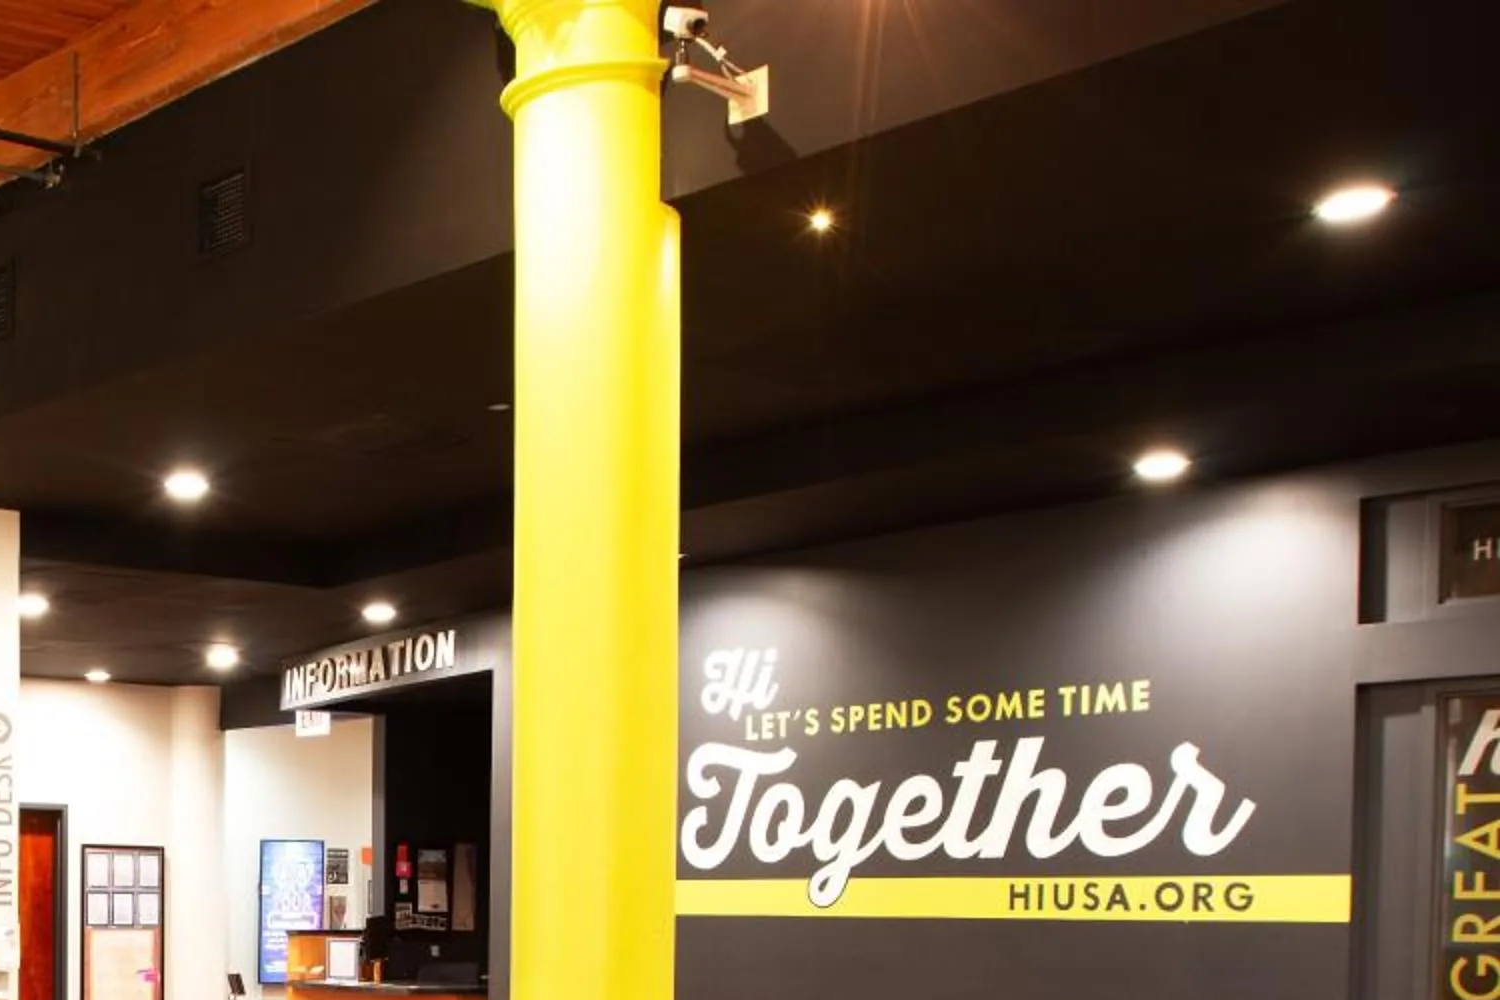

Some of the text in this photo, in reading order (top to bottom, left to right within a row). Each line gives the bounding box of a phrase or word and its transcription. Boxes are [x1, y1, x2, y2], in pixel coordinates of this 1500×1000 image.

[284, 630, 457, 702] INFORMATION
[700, 648, 780, 722] Hi
[745, 680, 1151, 741] LET'S SPEND SOME TIME
[680, 736, 1257, 908] Together
[1008, 883, 1254, 913] HIUSA.ORG
